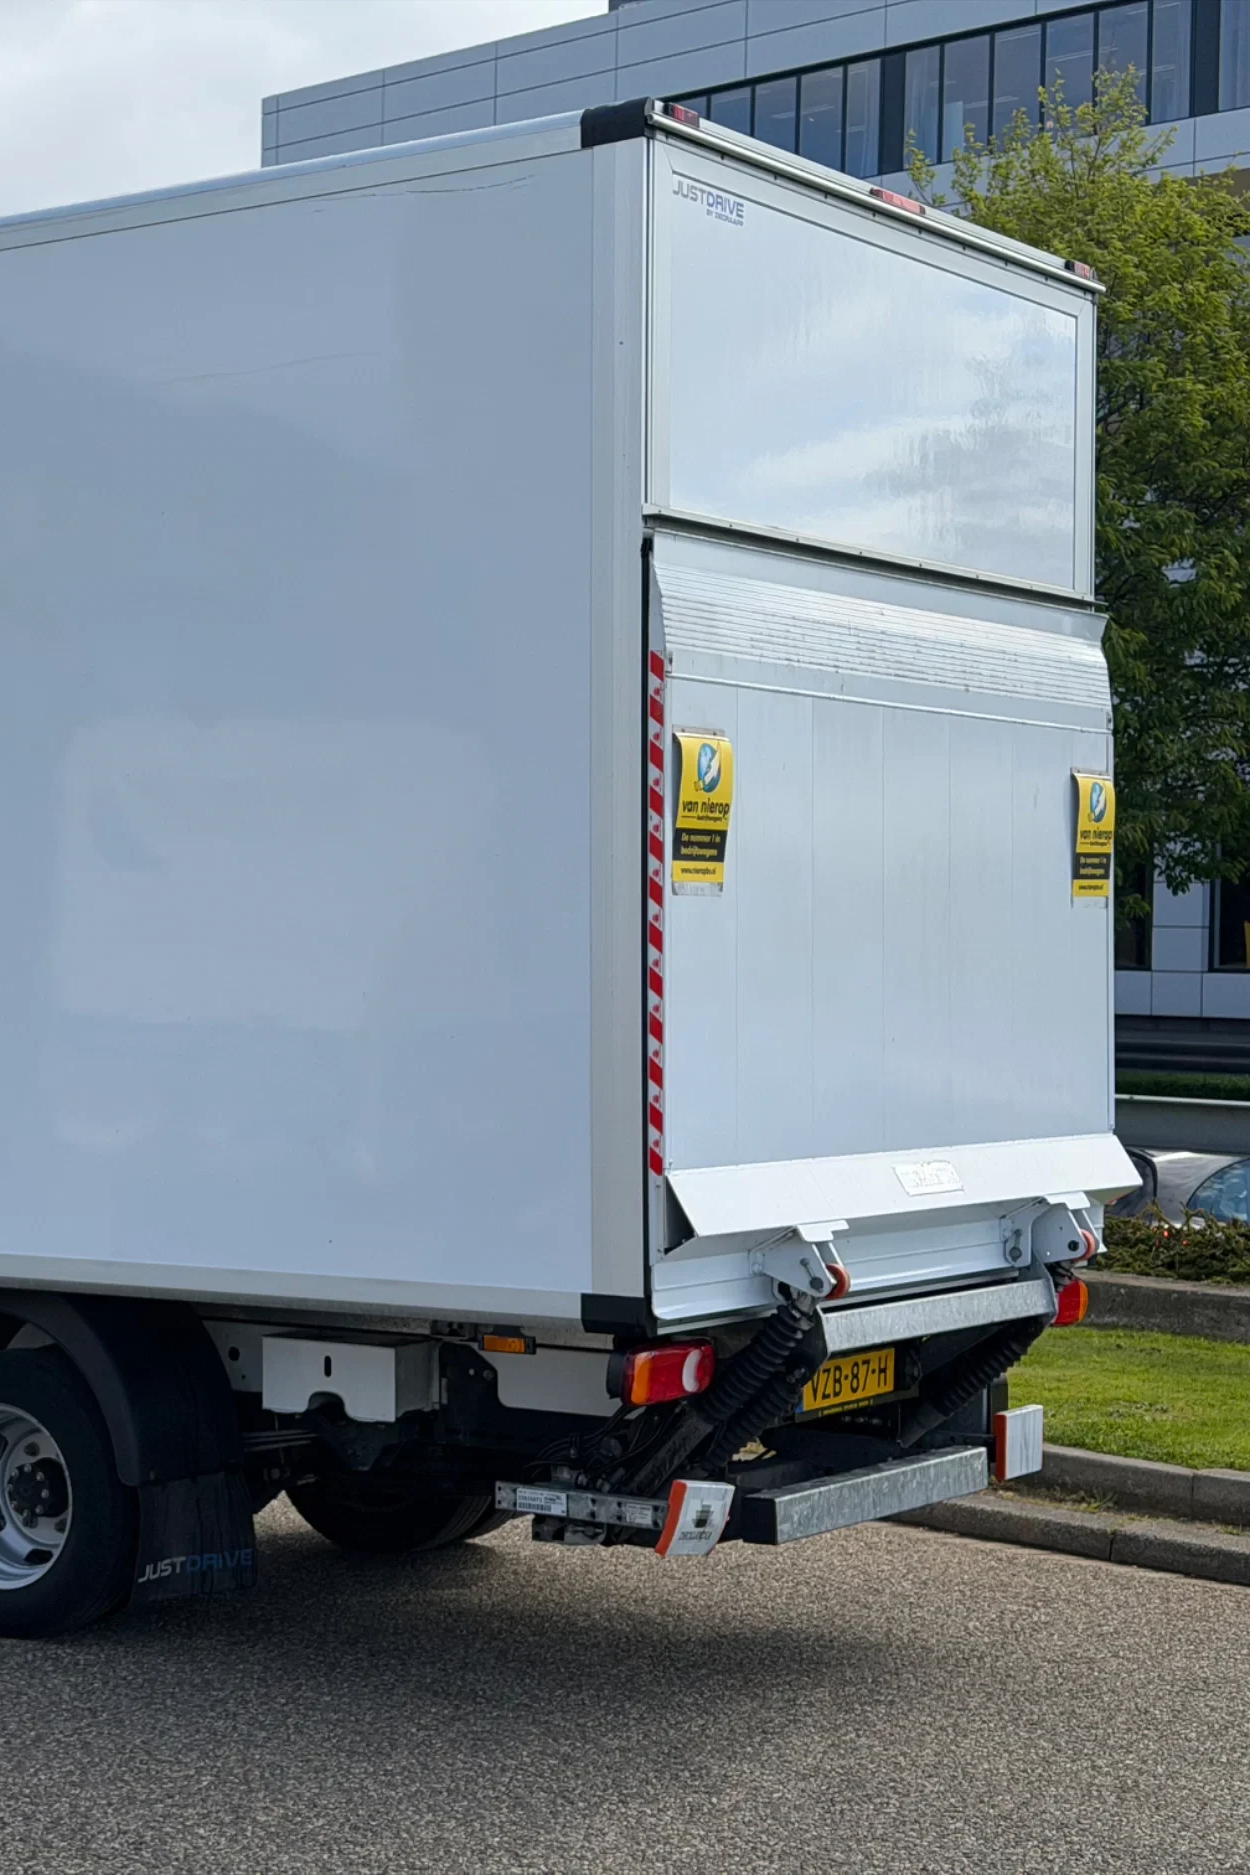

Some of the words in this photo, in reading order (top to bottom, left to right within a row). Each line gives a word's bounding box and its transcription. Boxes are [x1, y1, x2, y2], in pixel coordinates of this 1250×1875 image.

[672, 180, 745, 219] JUSTDRIVE
[682, 800, 699, 813] van
[701, 797, 731, 816] nierop
[811, 1354, 888, 1403] VZB-87-H
[137, 1548, 254, 1584] JUSTDRIVE
